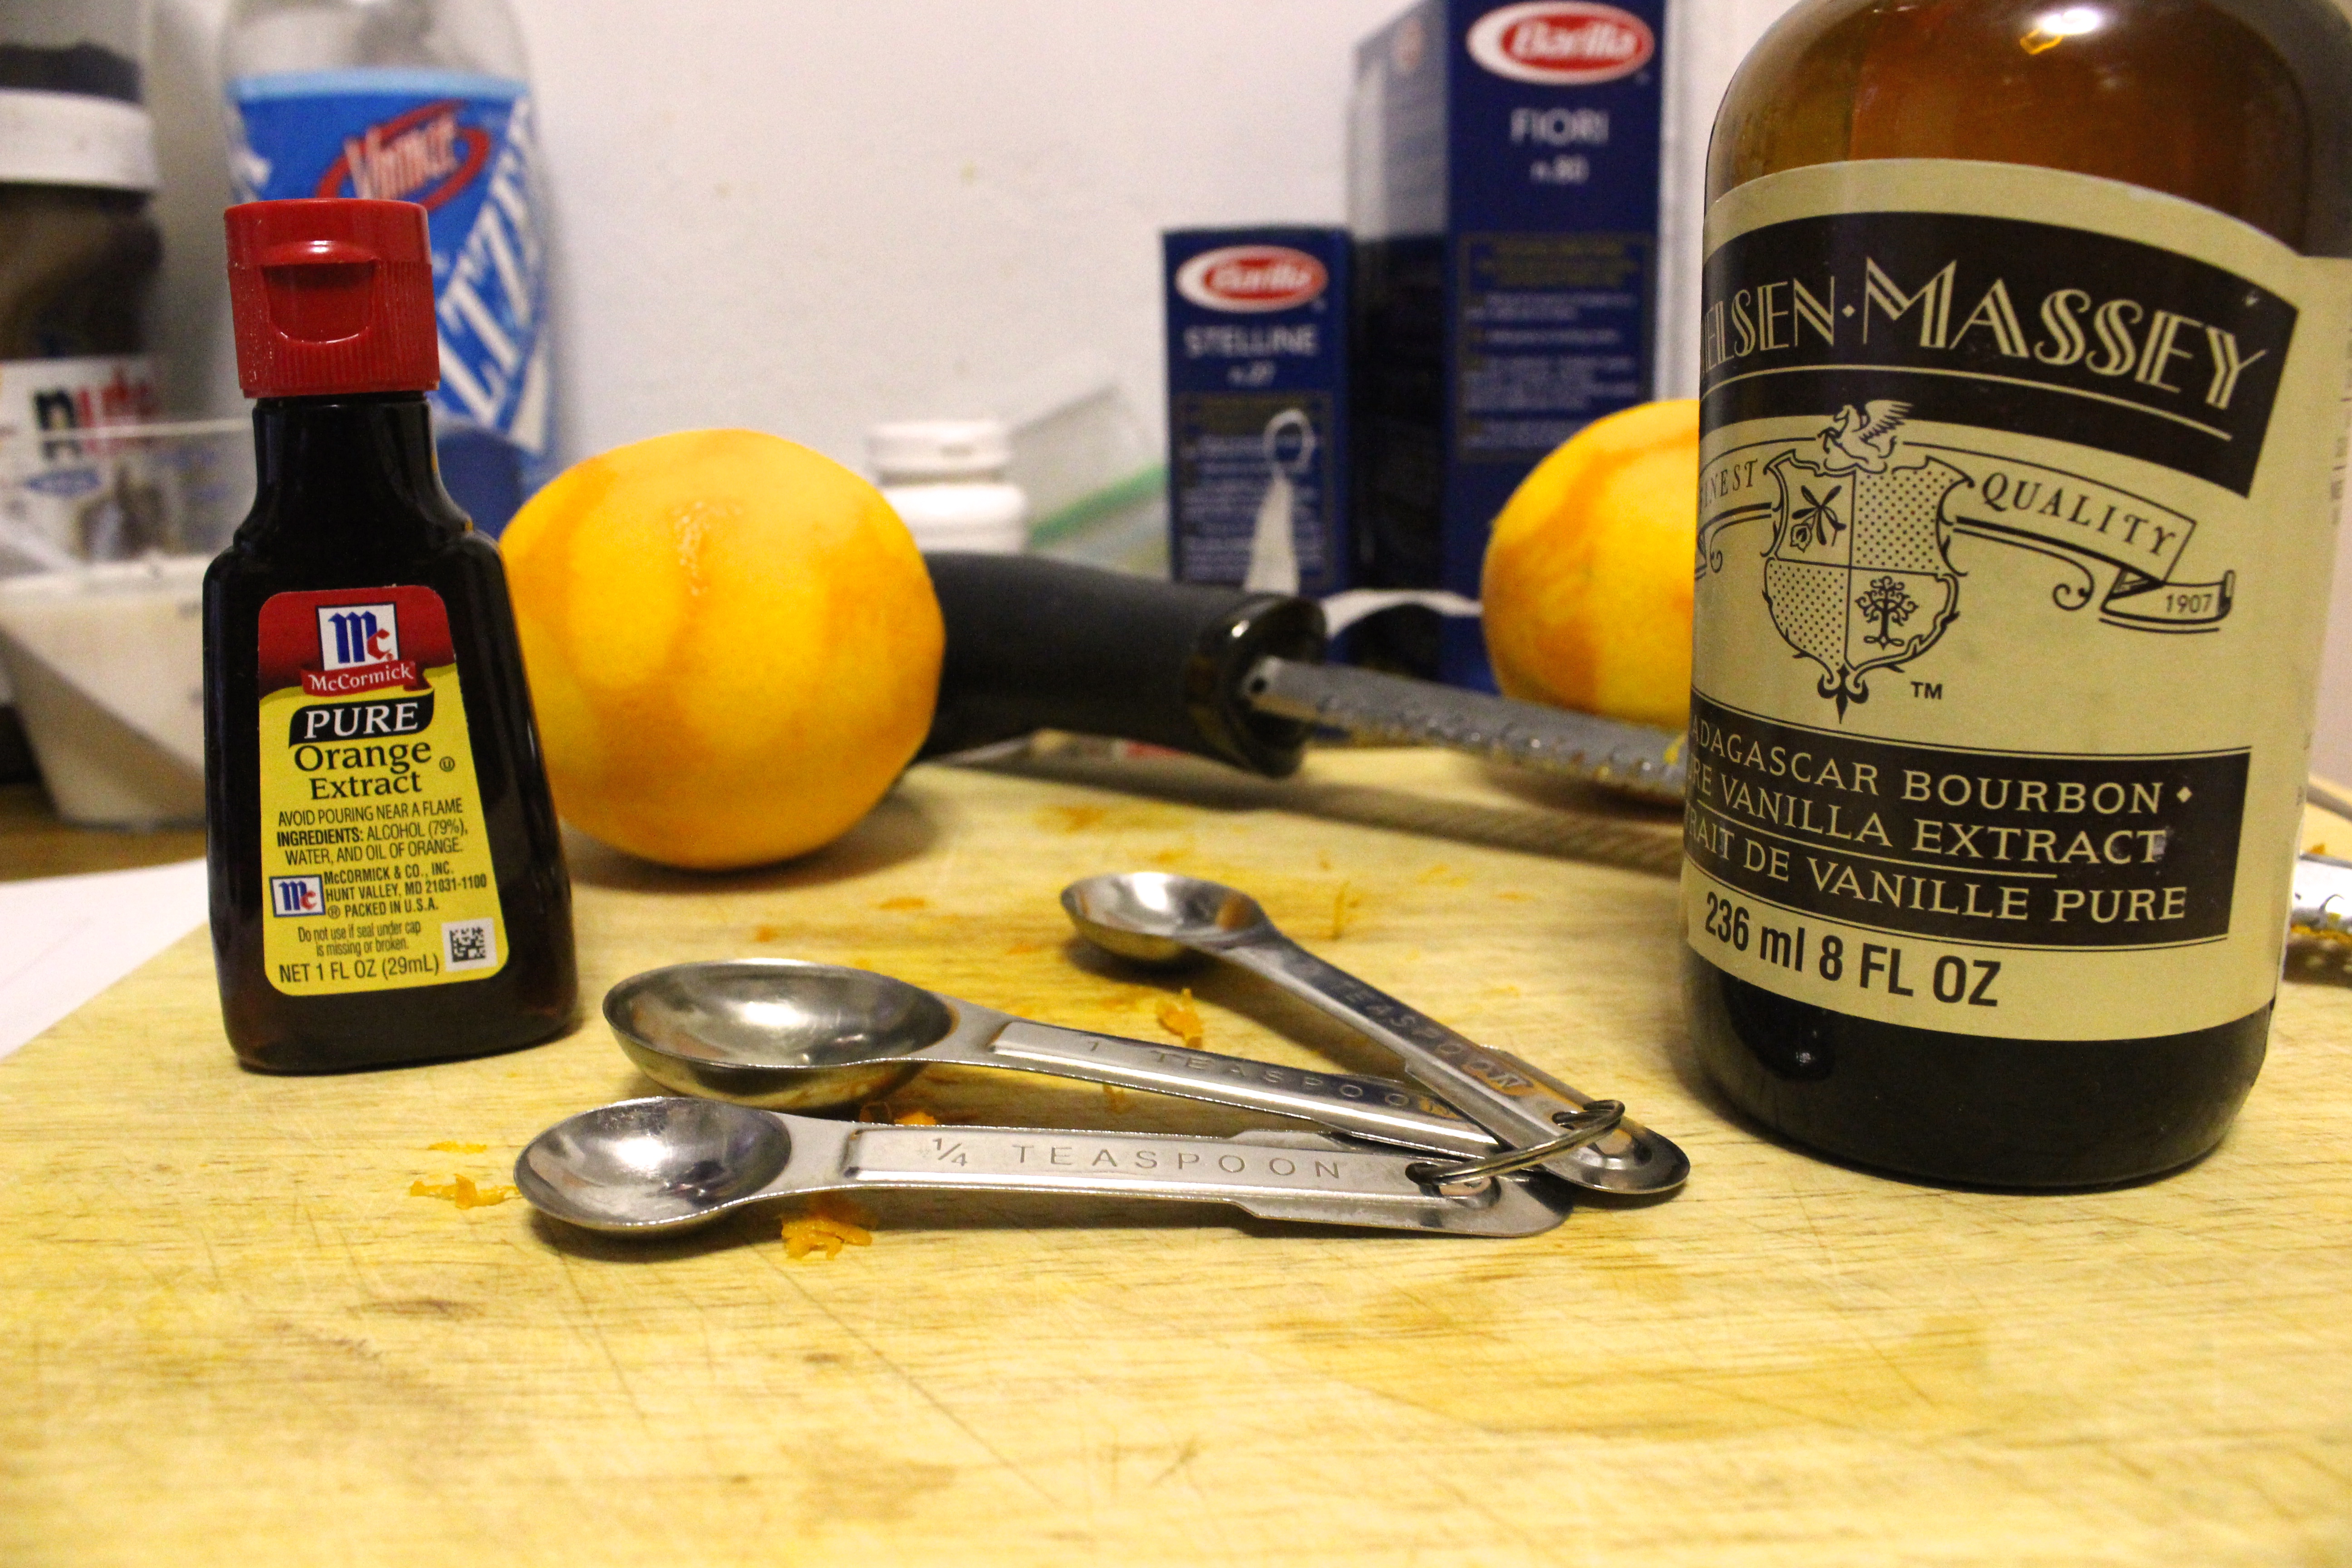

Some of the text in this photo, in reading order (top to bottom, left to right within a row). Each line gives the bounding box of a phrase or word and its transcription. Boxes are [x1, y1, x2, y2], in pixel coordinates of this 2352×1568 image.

[1702, 276, 1835, 374] ELSEN
[1863, 256, 2266, 410] MASSEY
[1700, 459, 2179, 555] INEST QUALITY
[2166, 593, 2212, 614] 1907
[309, 663, 414, 691] McCormick
[1911, 681, 1942, 700] TM
[304, 702, 418, 739] PURE
[294, 742, 431, 775] Orange
[1691, 715, 2162, 815] ADAGASCAR BOURBON
[309, 773, 422, 799] Extract
[279, 798, 462, 826] AVOID POURING NEAR A FLAME
[1721, 773, 1892, 847] VANILLA
[1912, 818, 2168, 865] EXTRACT
[277, 828, 363, 847] INGREDIENTS:
[368, 822, 425, 841] ALCOHOL
[285, 848, 333, 866] WATER,
[337, 846, 362, 862] AND
[366, 844, 387, 860] OIL
[390, 841, 405, 858] OF
[324, 867, 389, 885] McCORMICK
[394, 865, 401, 879] &
[432, 861, 453, 875] INC.
[1745, 838, 1790, 882] DE
[1807, 856, 2029, 921] VANILLE
[2050, 886, 2187, 924] PURE
[325, 886, 355, 902] HUNT
[405, 882, 422, 896] MD
[426, 873, 486, 894] 21031-1100
[345, 903, 386, 918] PACKED
[390, 901, 401, 914] IN
[405, 897, 439, 912] U.S.A.
[298, 921, 421, 942] Do not use if seal under cap
[316, 943, 324, 956] is
[327, 941, 361, 959] missing
[364, 941, 373, 951] or
[1705, 892, 2002, 1006] 236 ml 8 FL OZ
[279, 954, 440, 983] NET 1 FL OZ (29mL)
[1012, 1143, 1346, 1180] TEASPOON
